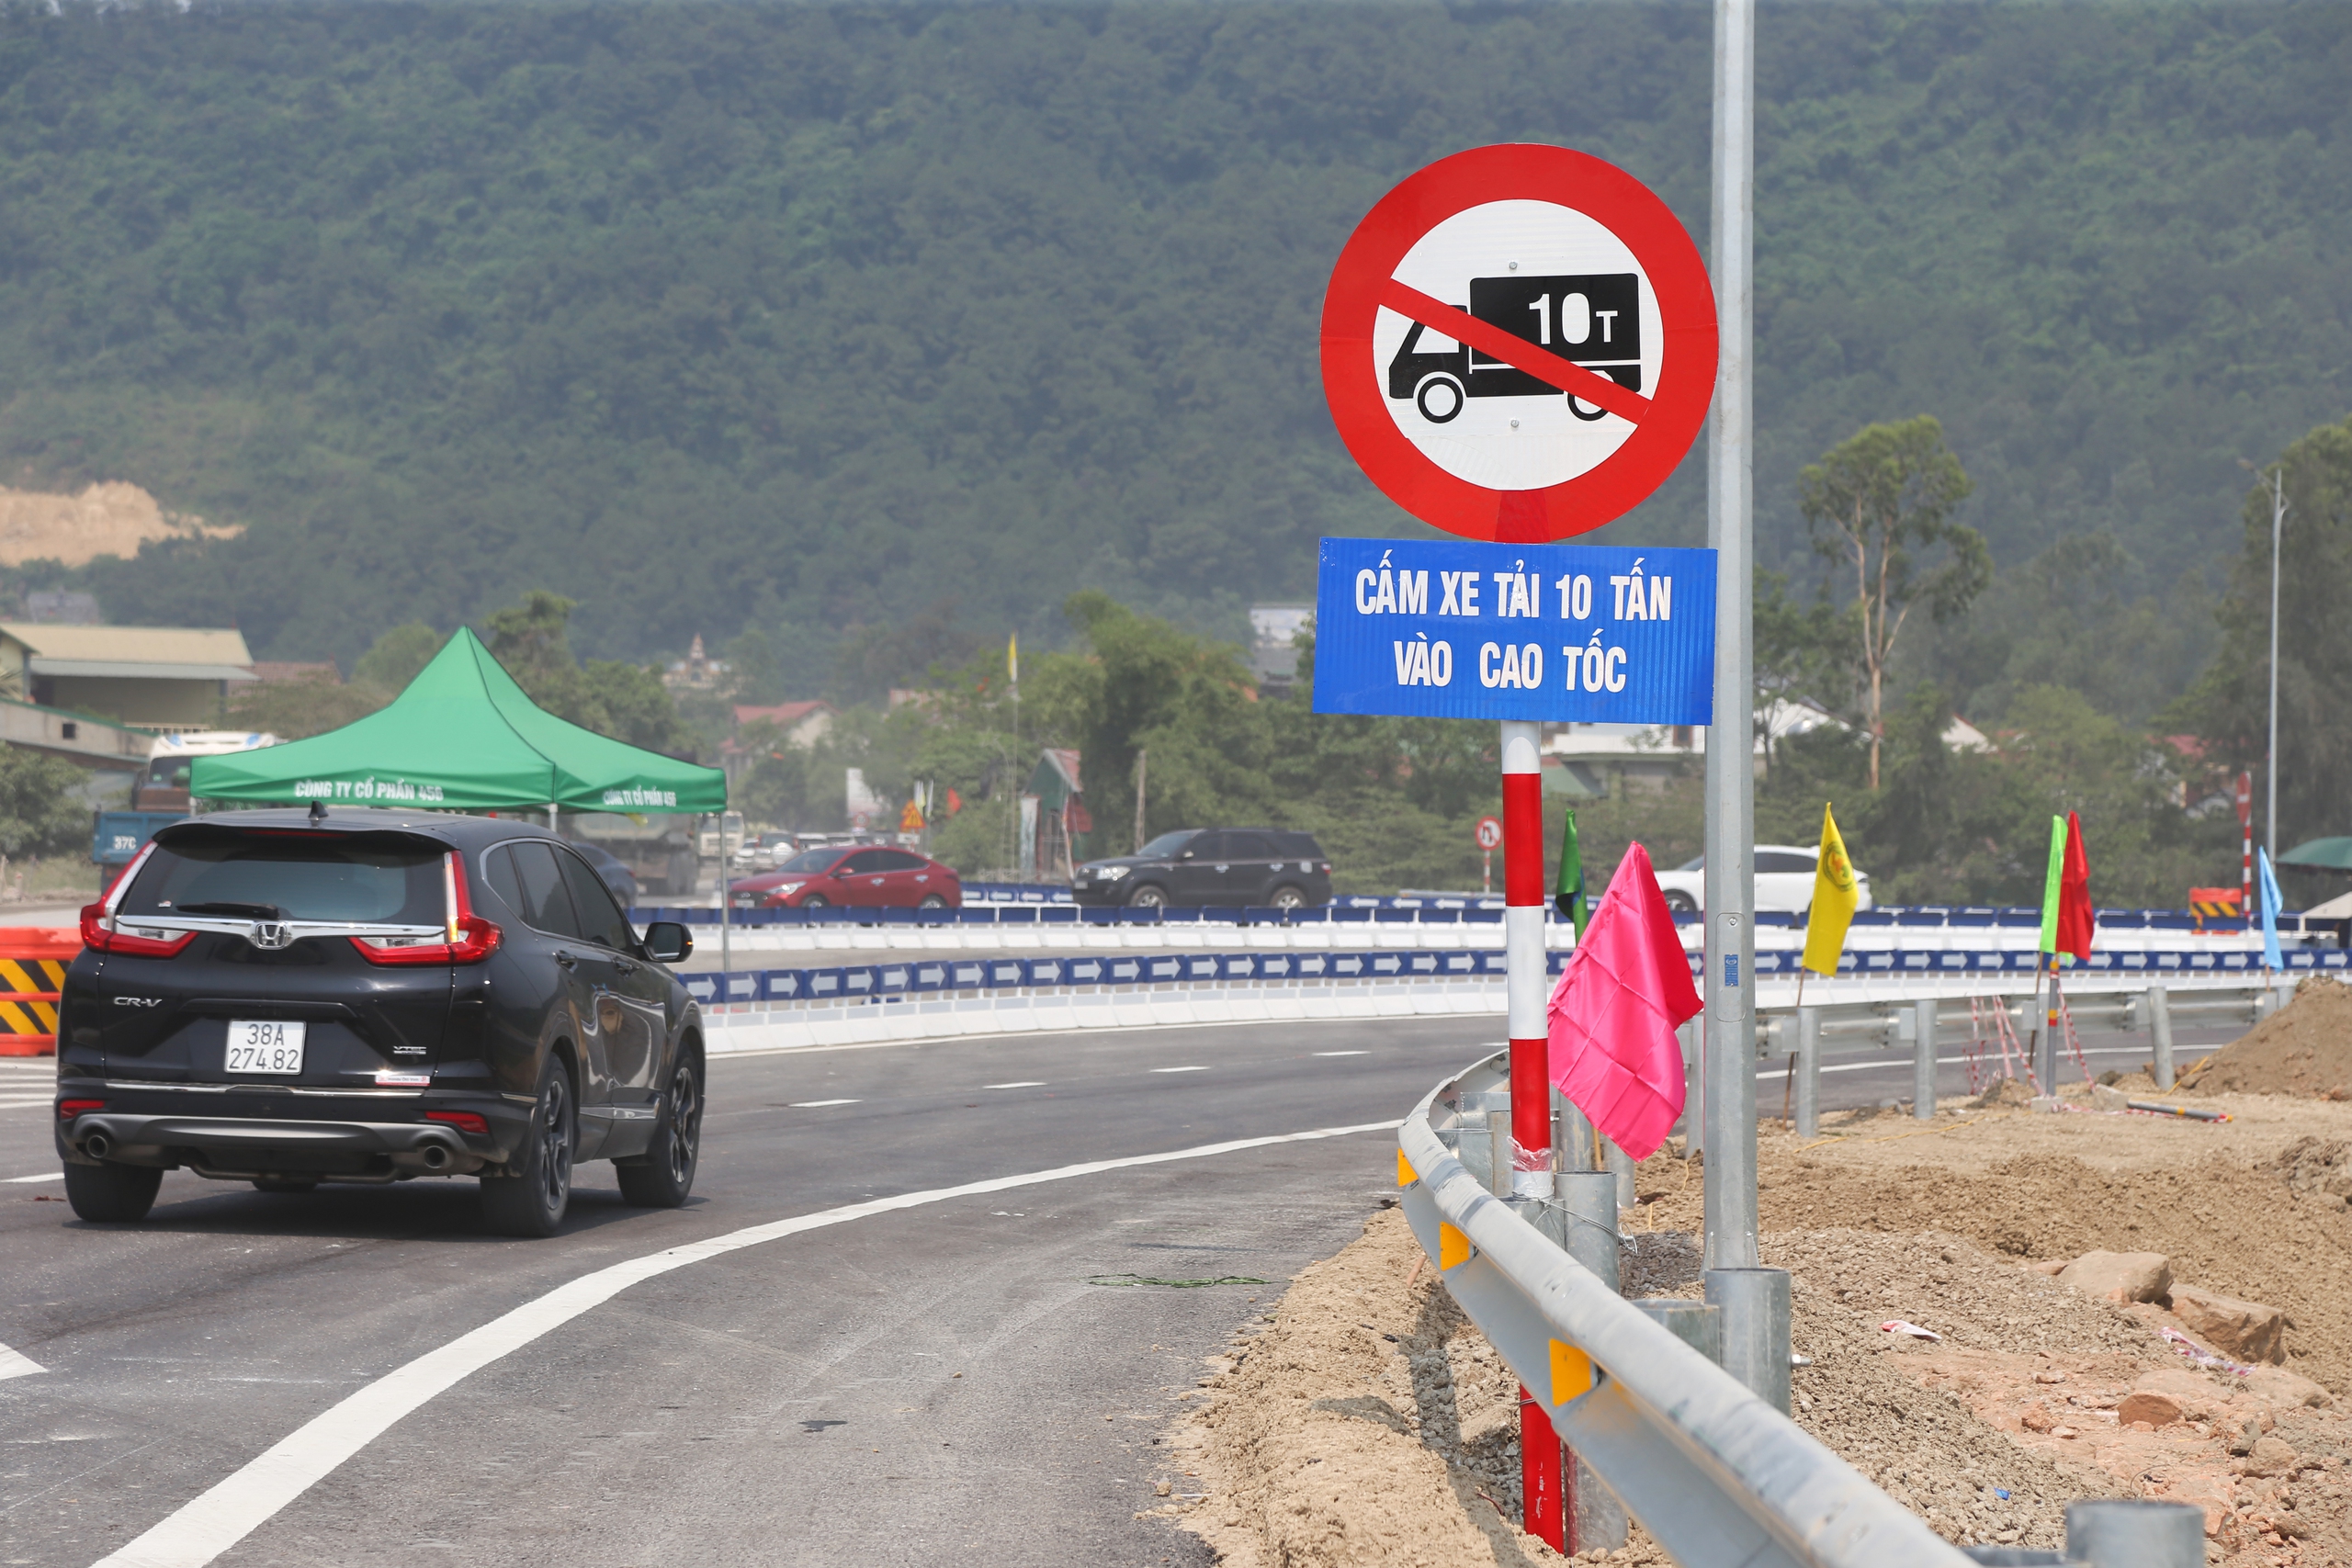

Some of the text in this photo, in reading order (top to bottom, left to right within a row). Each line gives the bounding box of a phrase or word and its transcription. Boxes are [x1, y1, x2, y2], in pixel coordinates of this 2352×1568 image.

[1529, 292, 1618, 344] 10T
[1355, 549, 1671, 621] CẤM XE TẢI 10 TẤN
[1394, 627, 1627, 693] VÀO CAO TỐC
[295, 778, 333, 797] CÔNG
[336, 781, 353, 798] TY
[355, 775, 375, 798] CỔ
[622, 790, 633, 806] TY
[114, 835, 137, 850] 37C
[114, 997, 163, 1007] CR-V
[247, 1023, 284, 1045] 38A
[229, 1048, 299, 1070] 274.82
